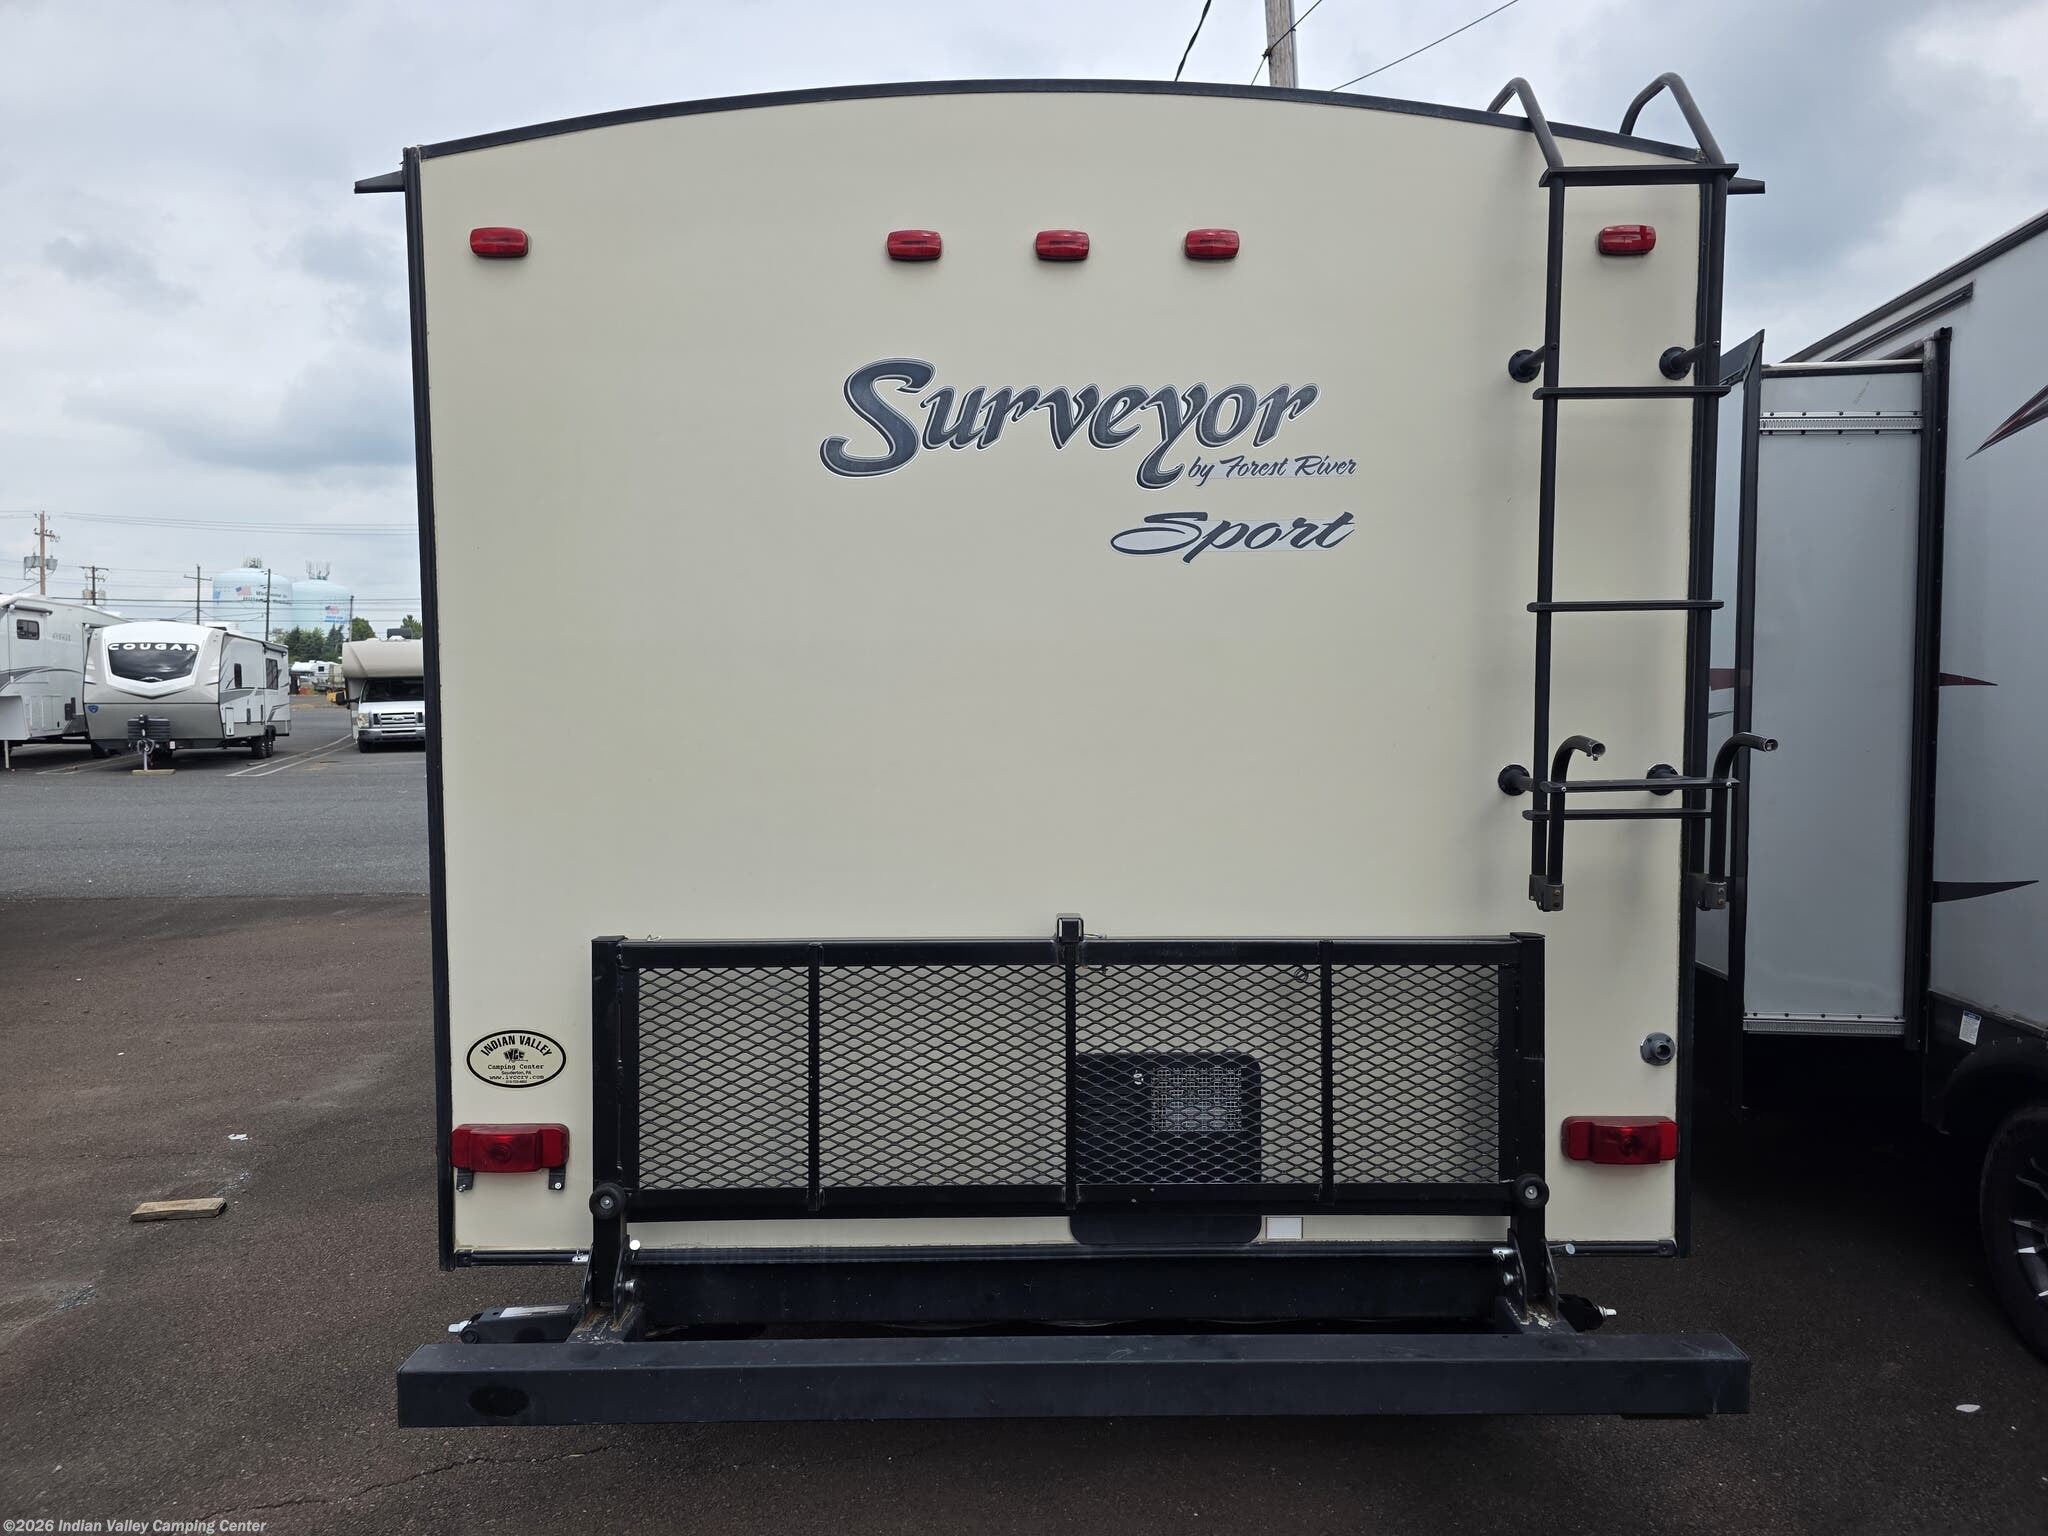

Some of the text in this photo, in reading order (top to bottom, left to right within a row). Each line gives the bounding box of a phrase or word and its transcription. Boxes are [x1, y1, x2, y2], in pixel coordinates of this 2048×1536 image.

[820, 357, 1320, 490] Surveyor
[1188, 456, 1357, 487] by Forest River
[1110, 511, 1356, 564] Sport
[108, 643, 198, 651] COUGAR
[481, 1035, 552, 1056] INDIAN VALLEY
